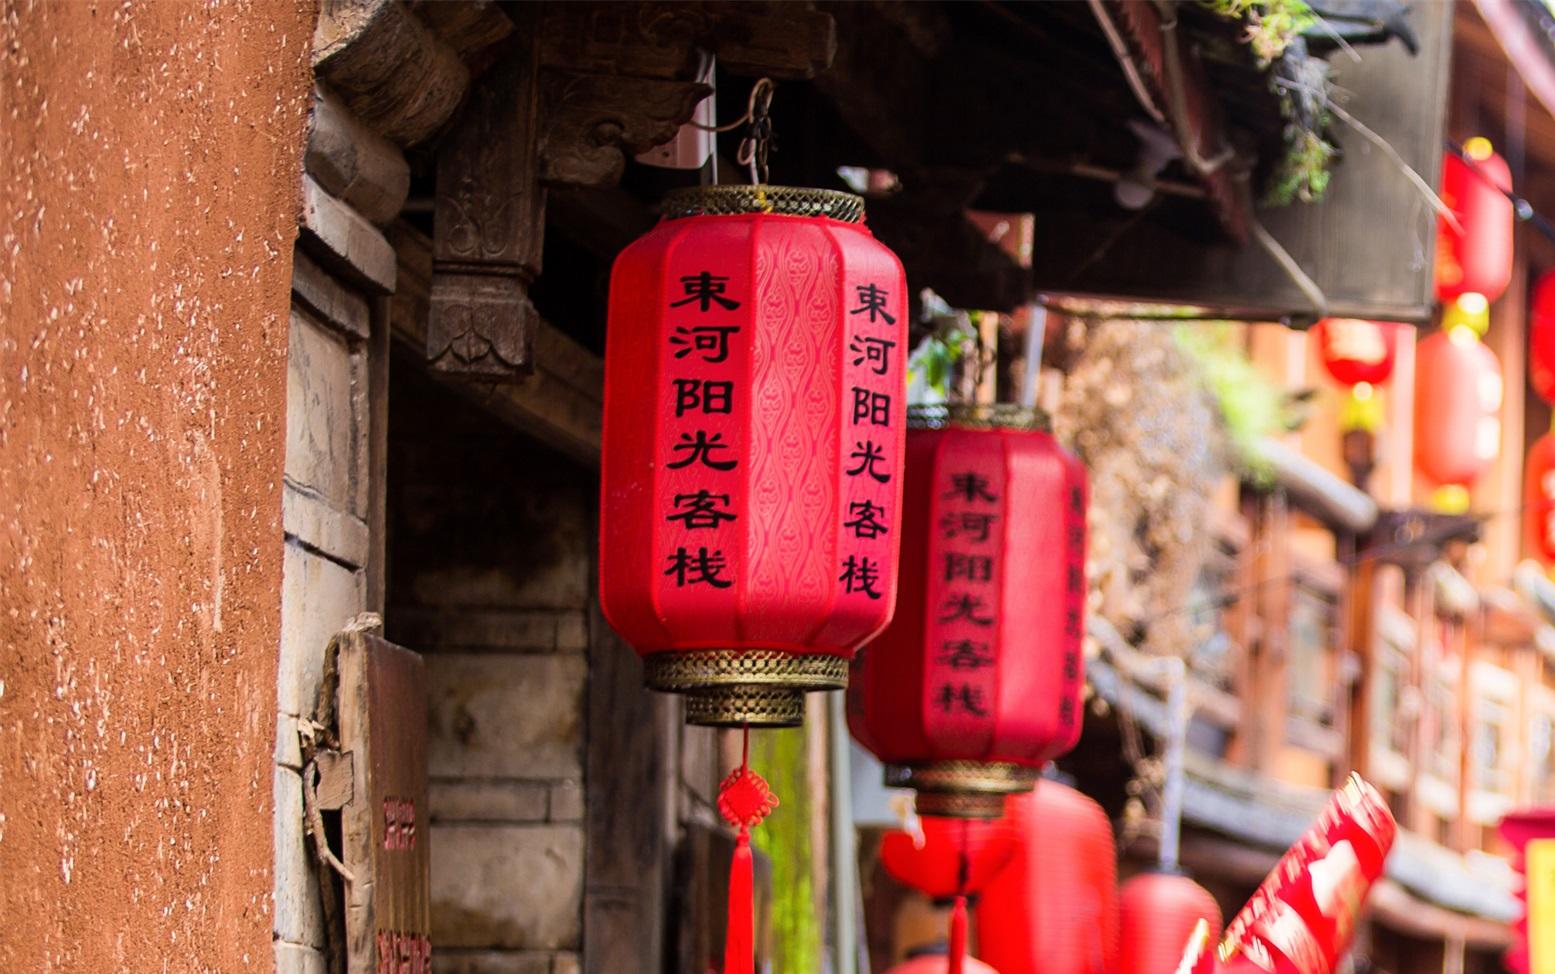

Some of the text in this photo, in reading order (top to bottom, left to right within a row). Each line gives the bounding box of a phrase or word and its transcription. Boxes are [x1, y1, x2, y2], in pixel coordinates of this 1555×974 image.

[665, 271, 741, 590] 束河阳光客栈
[838, 283, 897, 600] 束河阳光客栈
